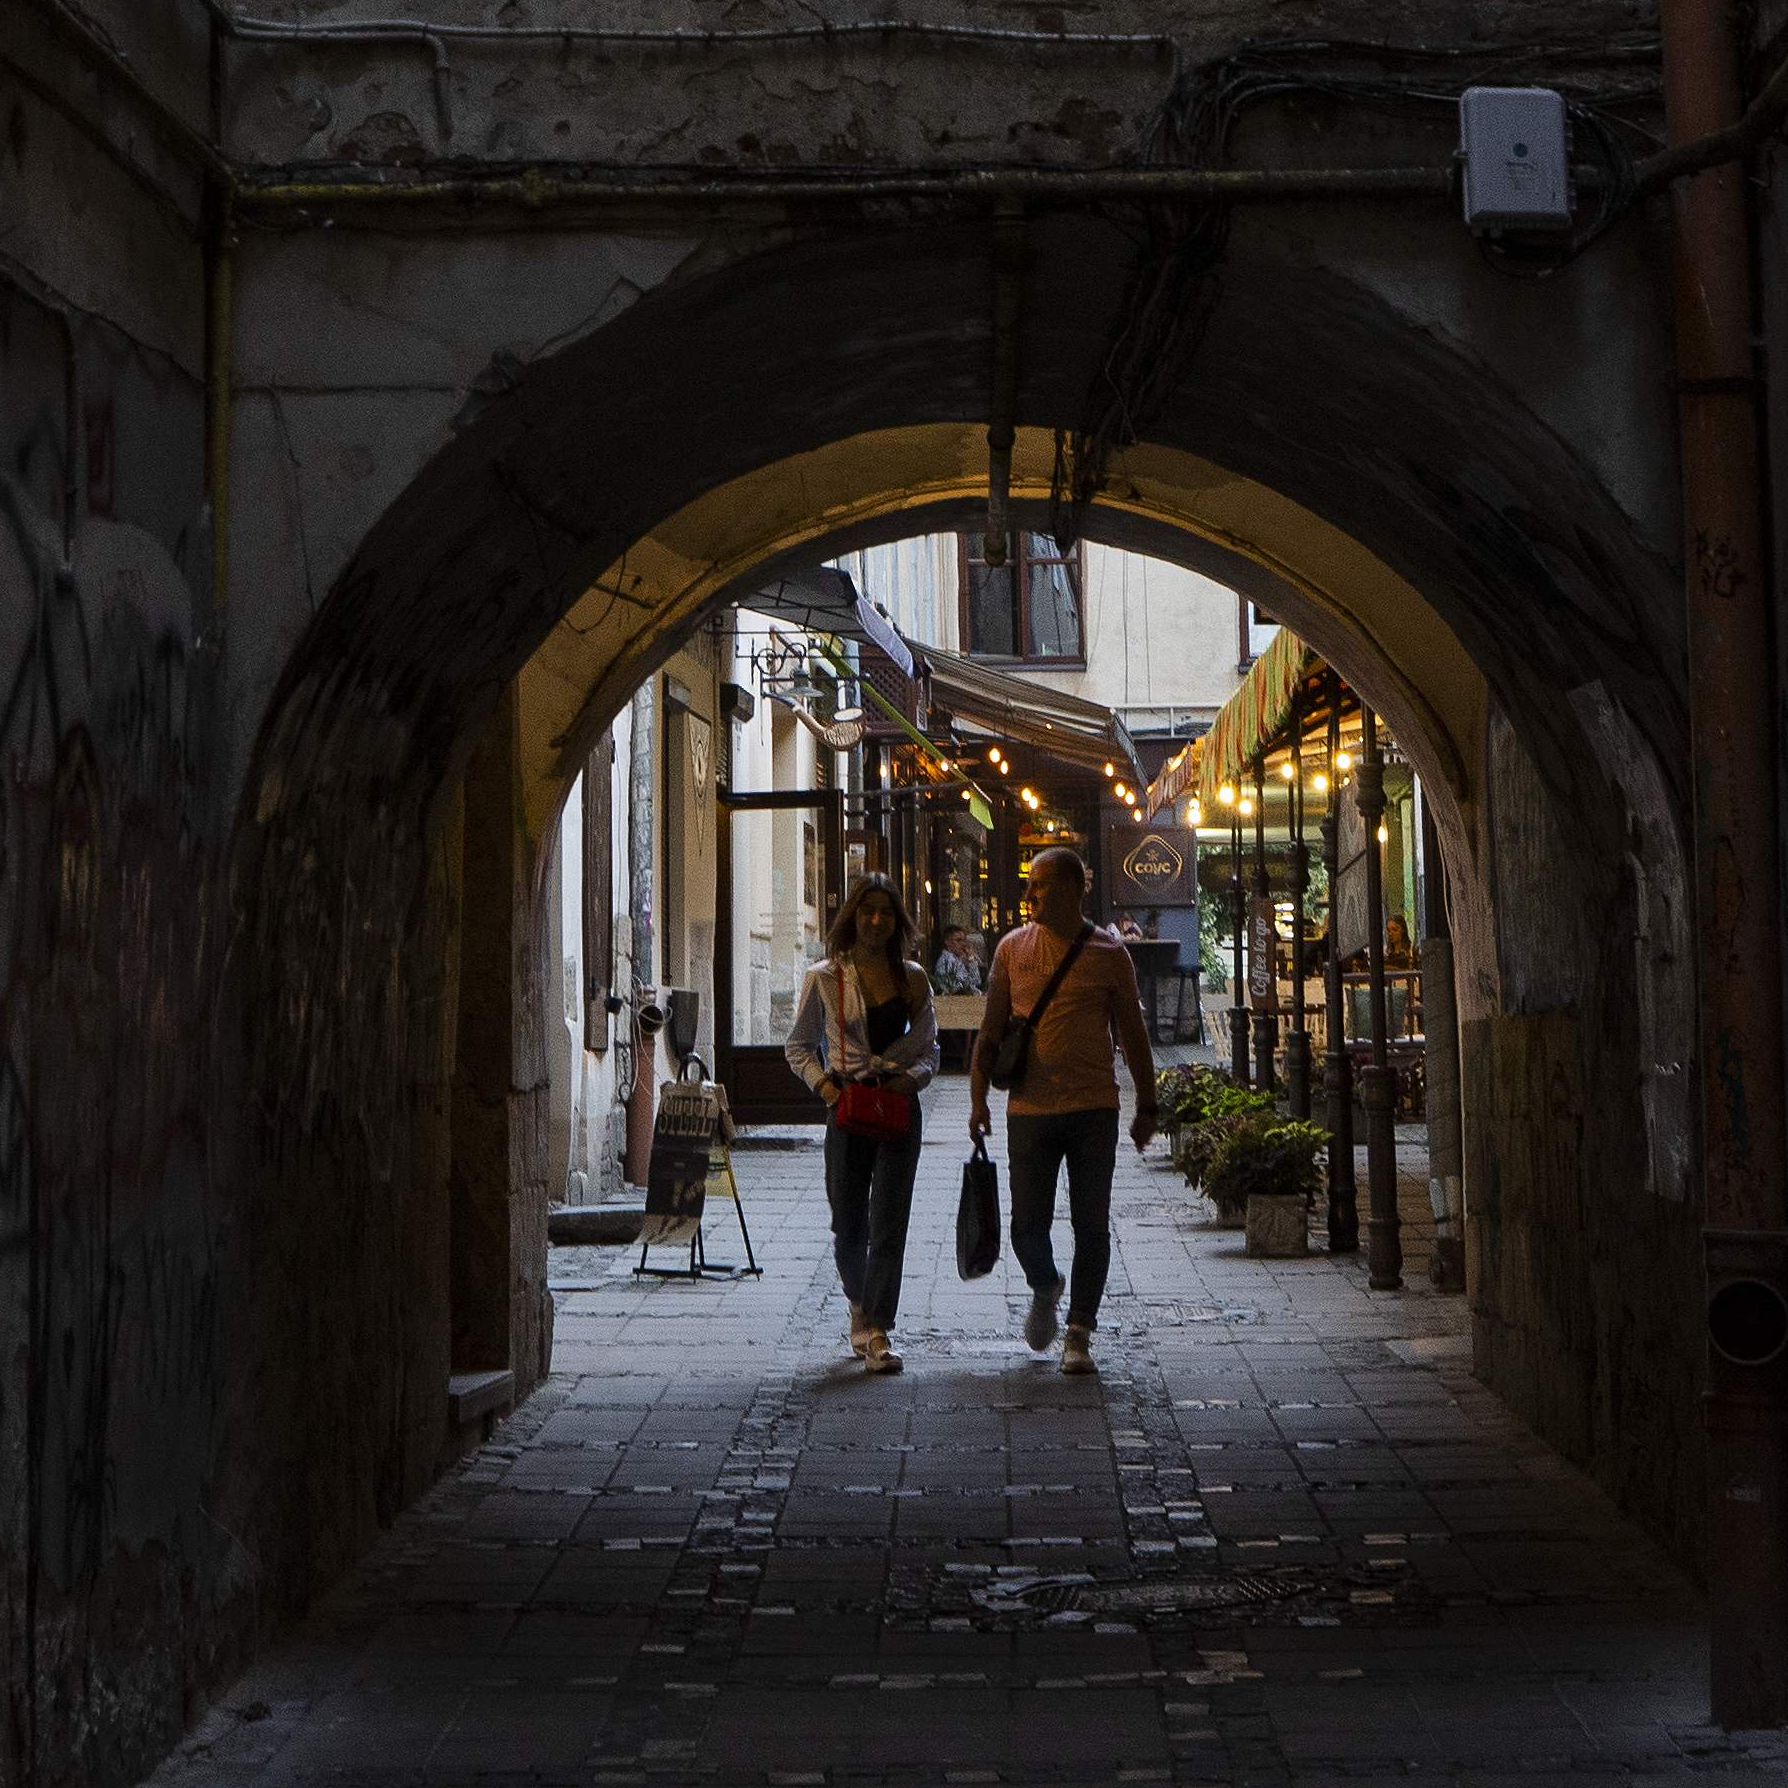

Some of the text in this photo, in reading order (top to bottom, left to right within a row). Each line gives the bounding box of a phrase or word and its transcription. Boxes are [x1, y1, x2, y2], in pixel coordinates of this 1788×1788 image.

[1251, 915, 1272, 998] Coffee to go
